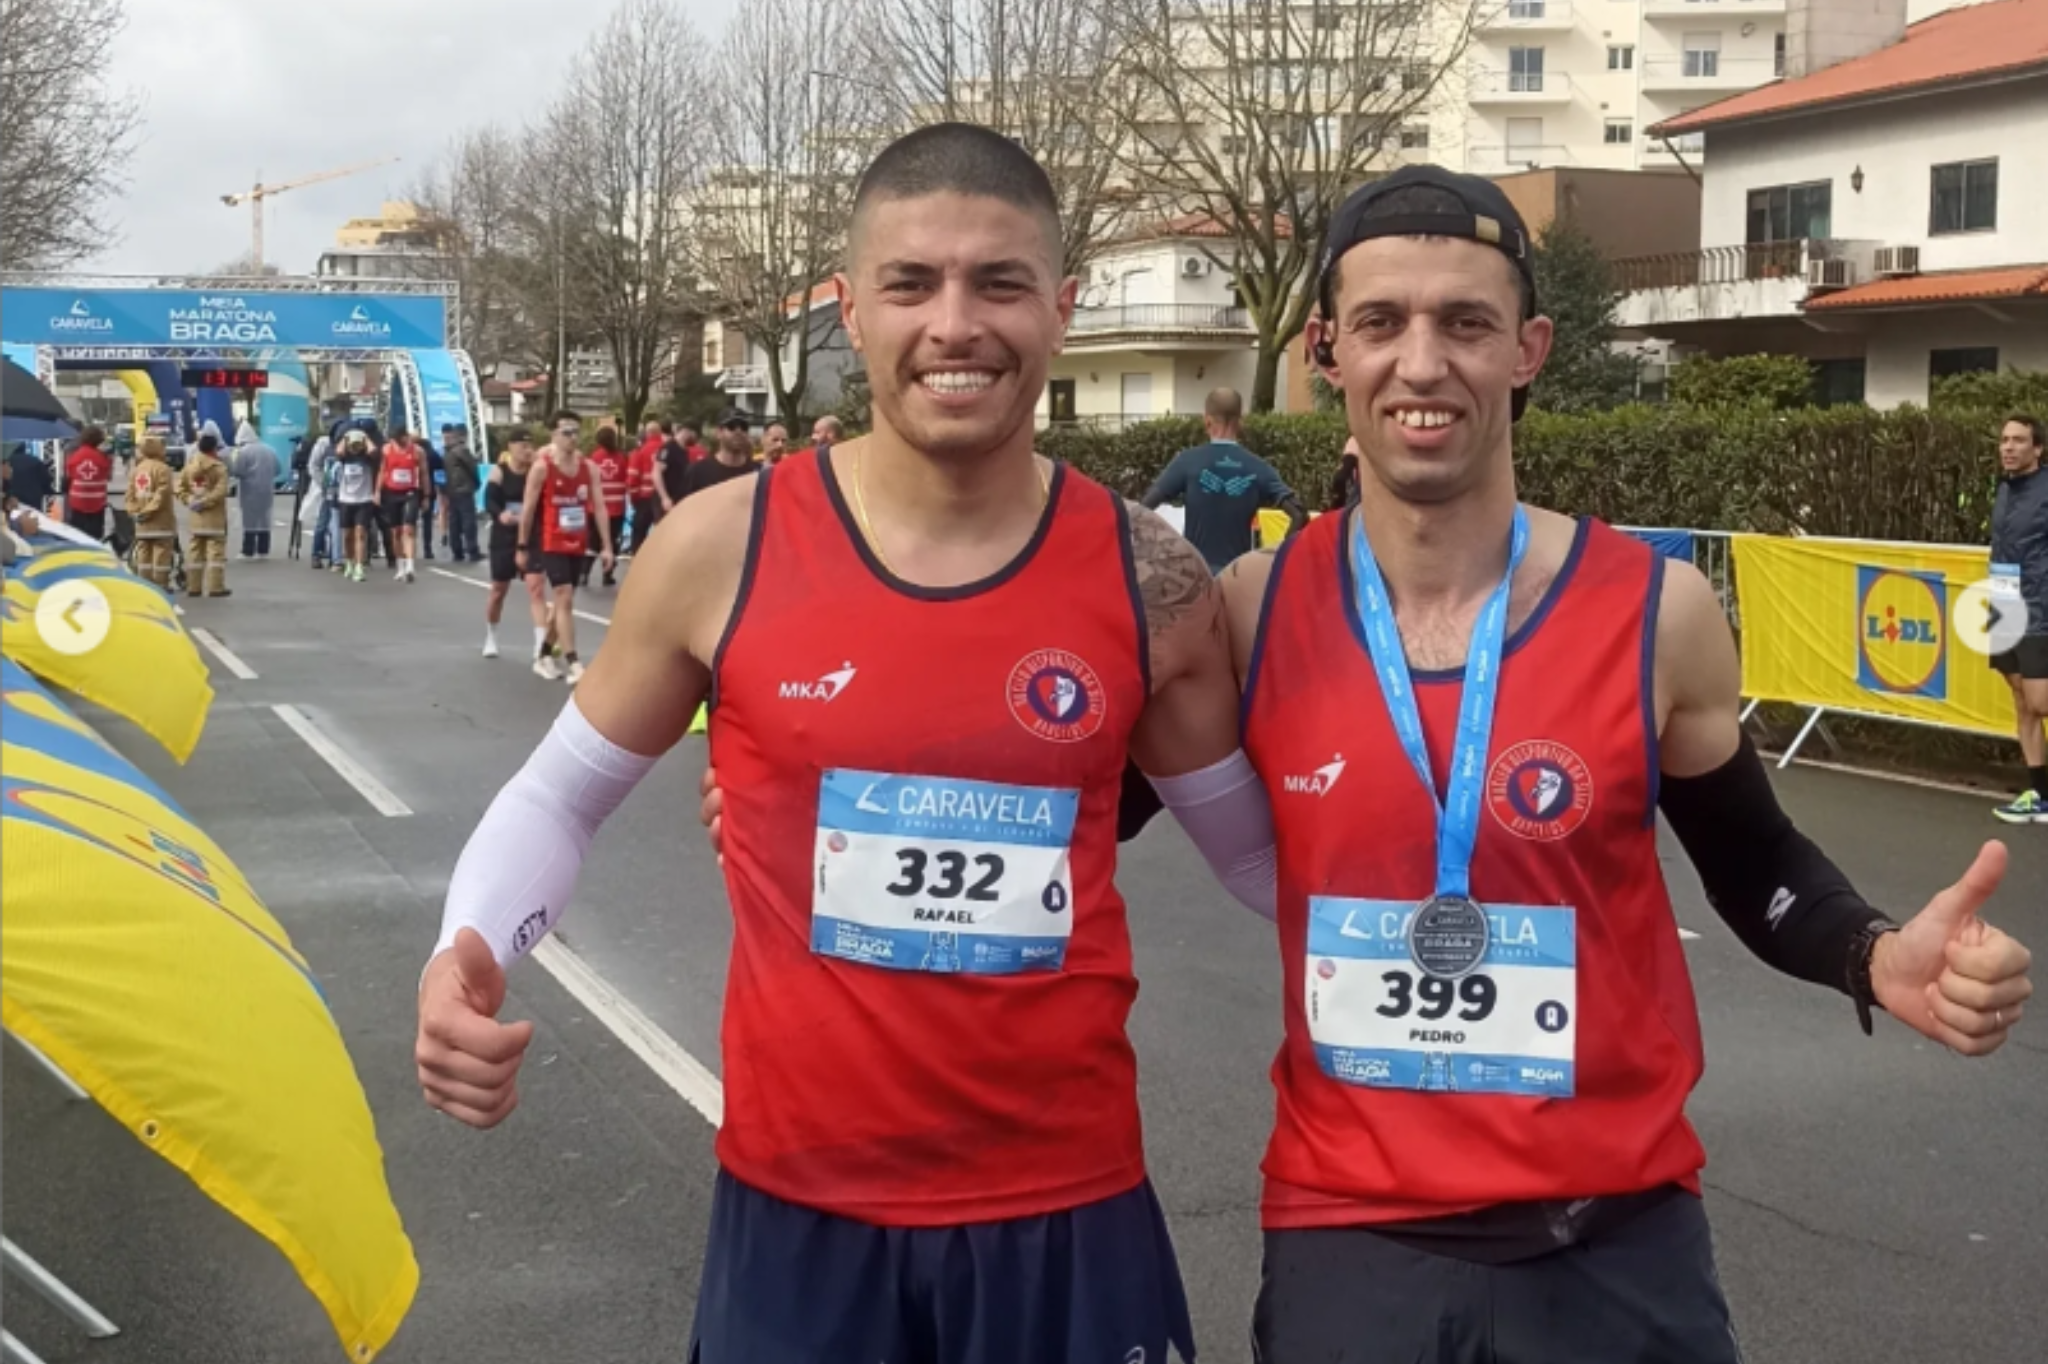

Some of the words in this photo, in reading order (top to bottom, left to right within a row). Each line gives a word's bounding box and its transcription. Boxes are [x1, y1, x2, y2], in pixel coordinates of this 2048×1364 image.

[200, 297, 246, 308] MEIA
[51, 317, 113, 330] CARAVELA
[169, 309, 277, 322] MARATONA
[170, 323, 277, 342] BRAGA
[331, 321, 391, 333] CARAVELA
[779, 681, 827, 699] MKA
[1284, 775, 1321, 793] MKA
[897, 785, 1053, 826] CARAVELA
[886, 847, 1005, 901] 332
[913, 907, 976, 924] RAFAEL
[1375, 969, 1498, 1022] 399
[1409, 1029, 1466, 1044] PEDRO
